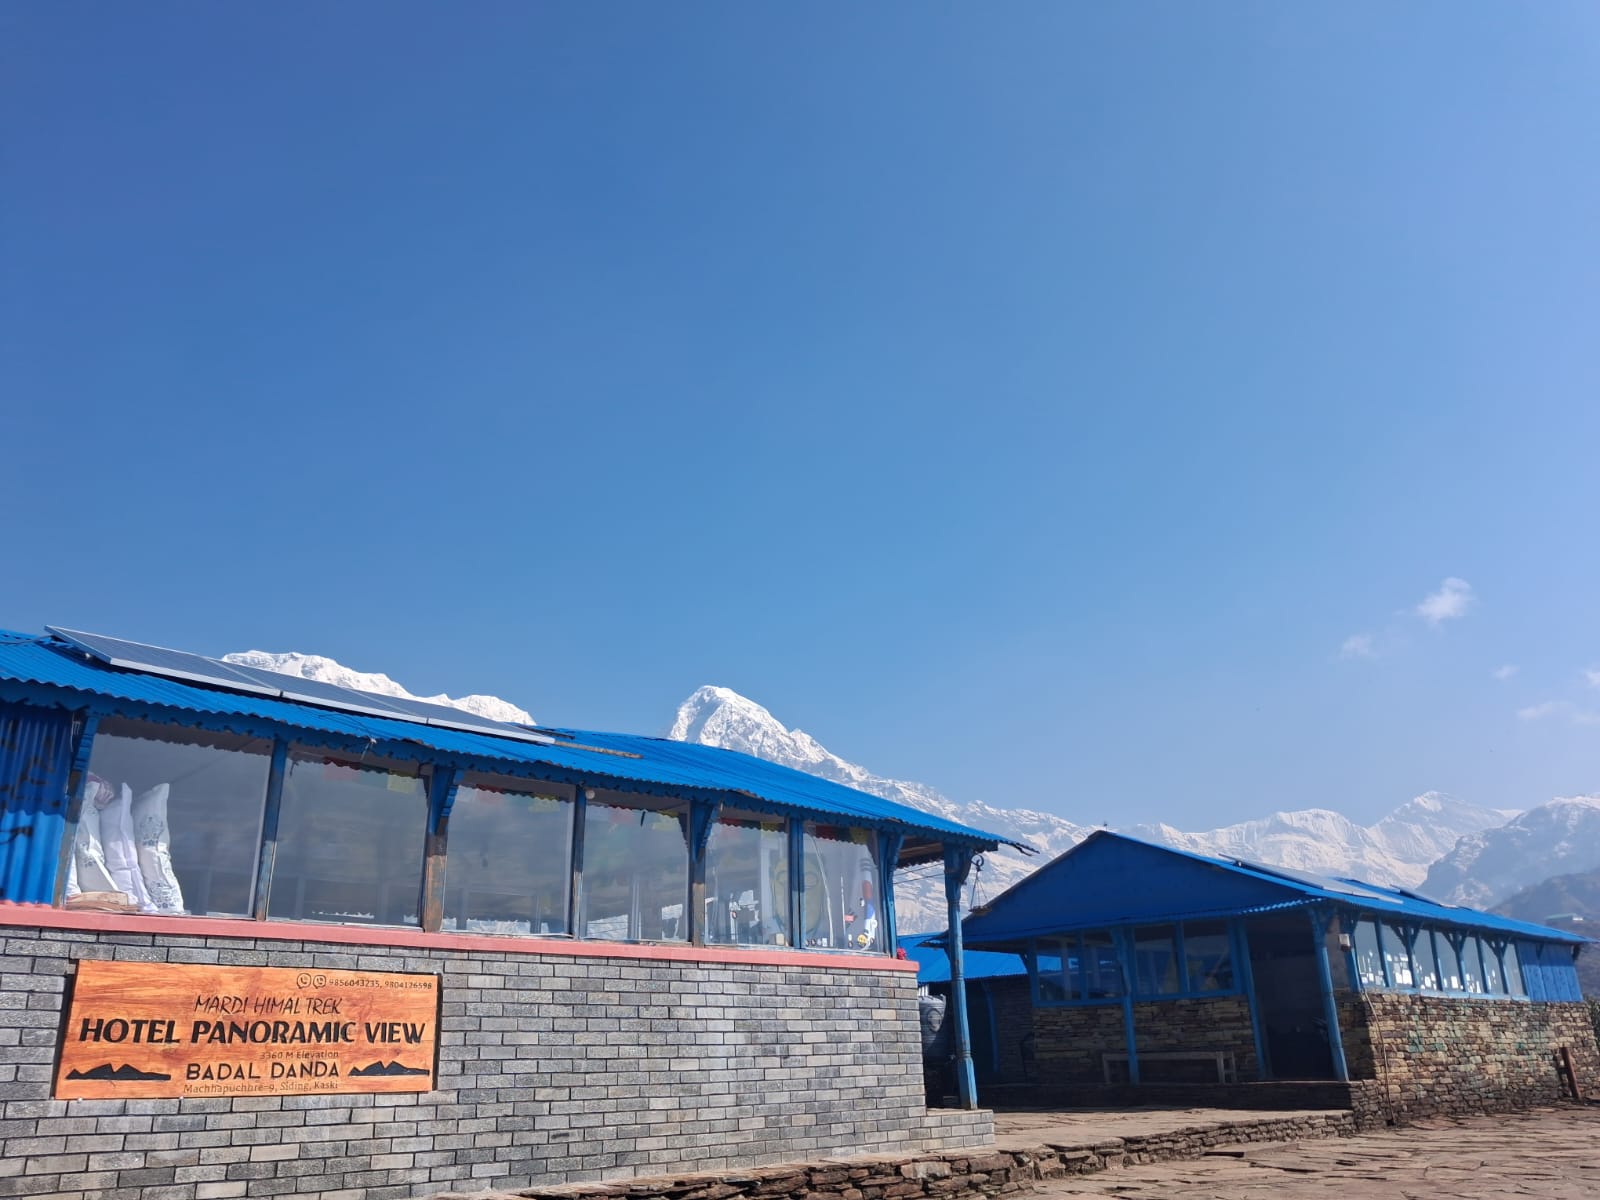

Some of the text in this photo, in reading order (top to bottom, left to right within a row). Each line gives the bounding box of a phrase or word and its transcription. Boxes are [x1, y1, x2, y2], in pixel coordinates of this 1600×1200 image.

[194, 995, 343, 1016] MARDI HIMAL TREK
[79, 1018, 426, 1044] HOTEL PANORAMIC VIEW
[285, 1051, 294, 1060] M
[296, 1050, 339, 1060] Elevation
[186, 1061, 339, 1081] BADAL DANDA
[314, 1079, 339, 1090] Kaski
